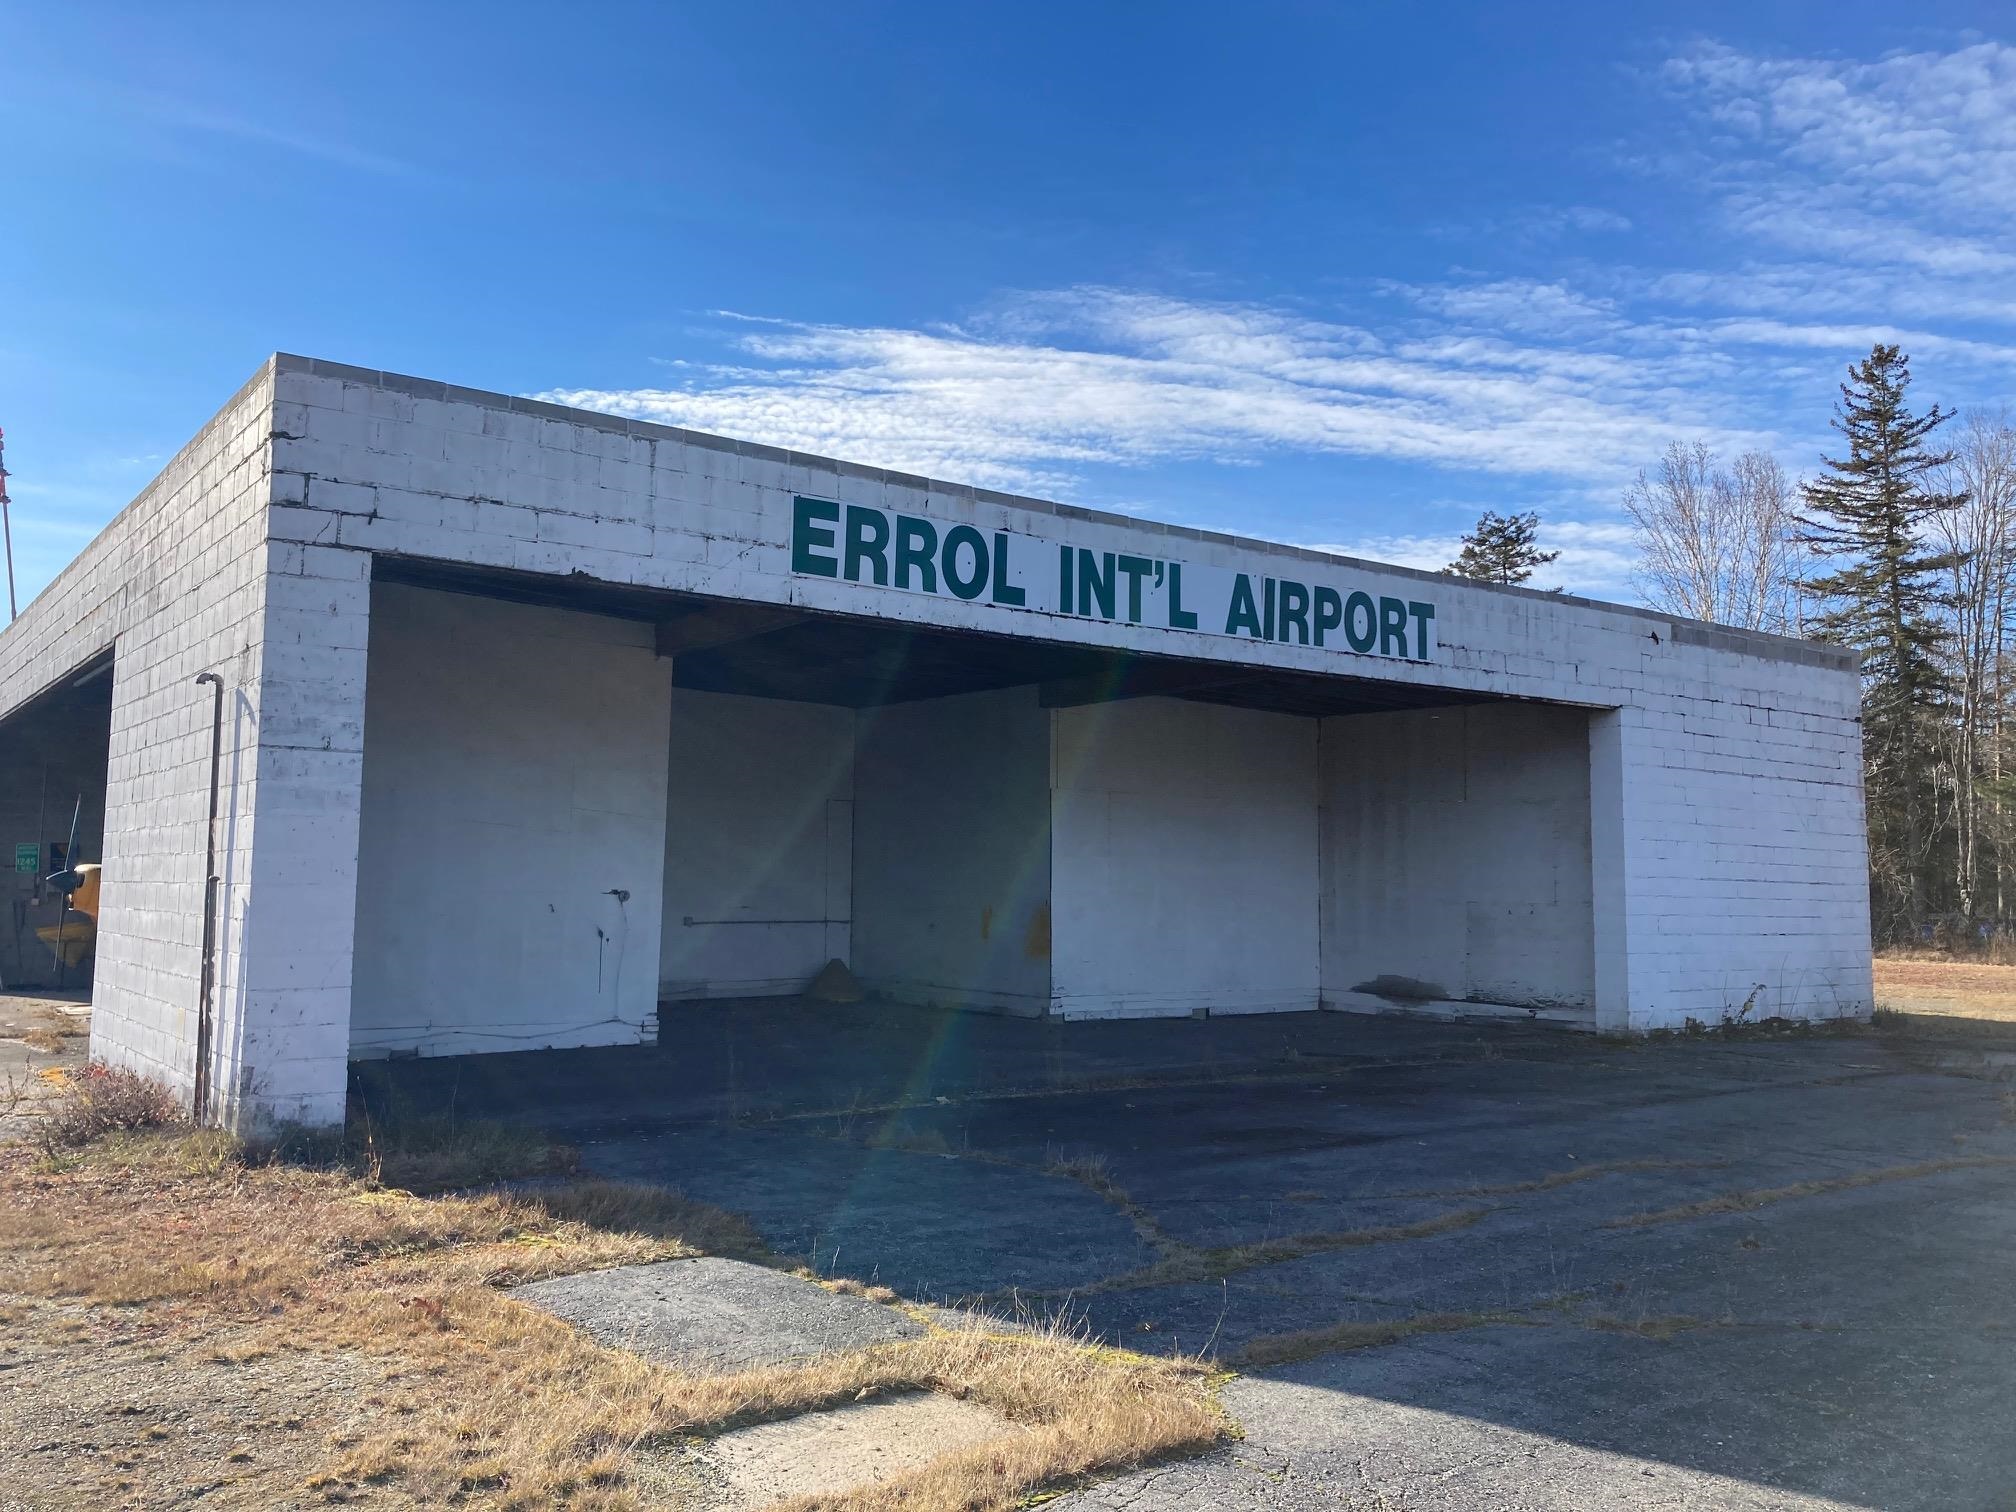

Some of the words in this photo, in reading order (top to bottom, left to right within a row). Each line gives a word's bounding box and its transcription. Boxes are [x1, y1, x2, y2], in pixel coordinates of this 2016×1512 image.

[792, 496, 1025, 606] ERROL
[1060, 545, 1198, 630] INT'L
[1225, 573, 1435, 660] AIRPORT
